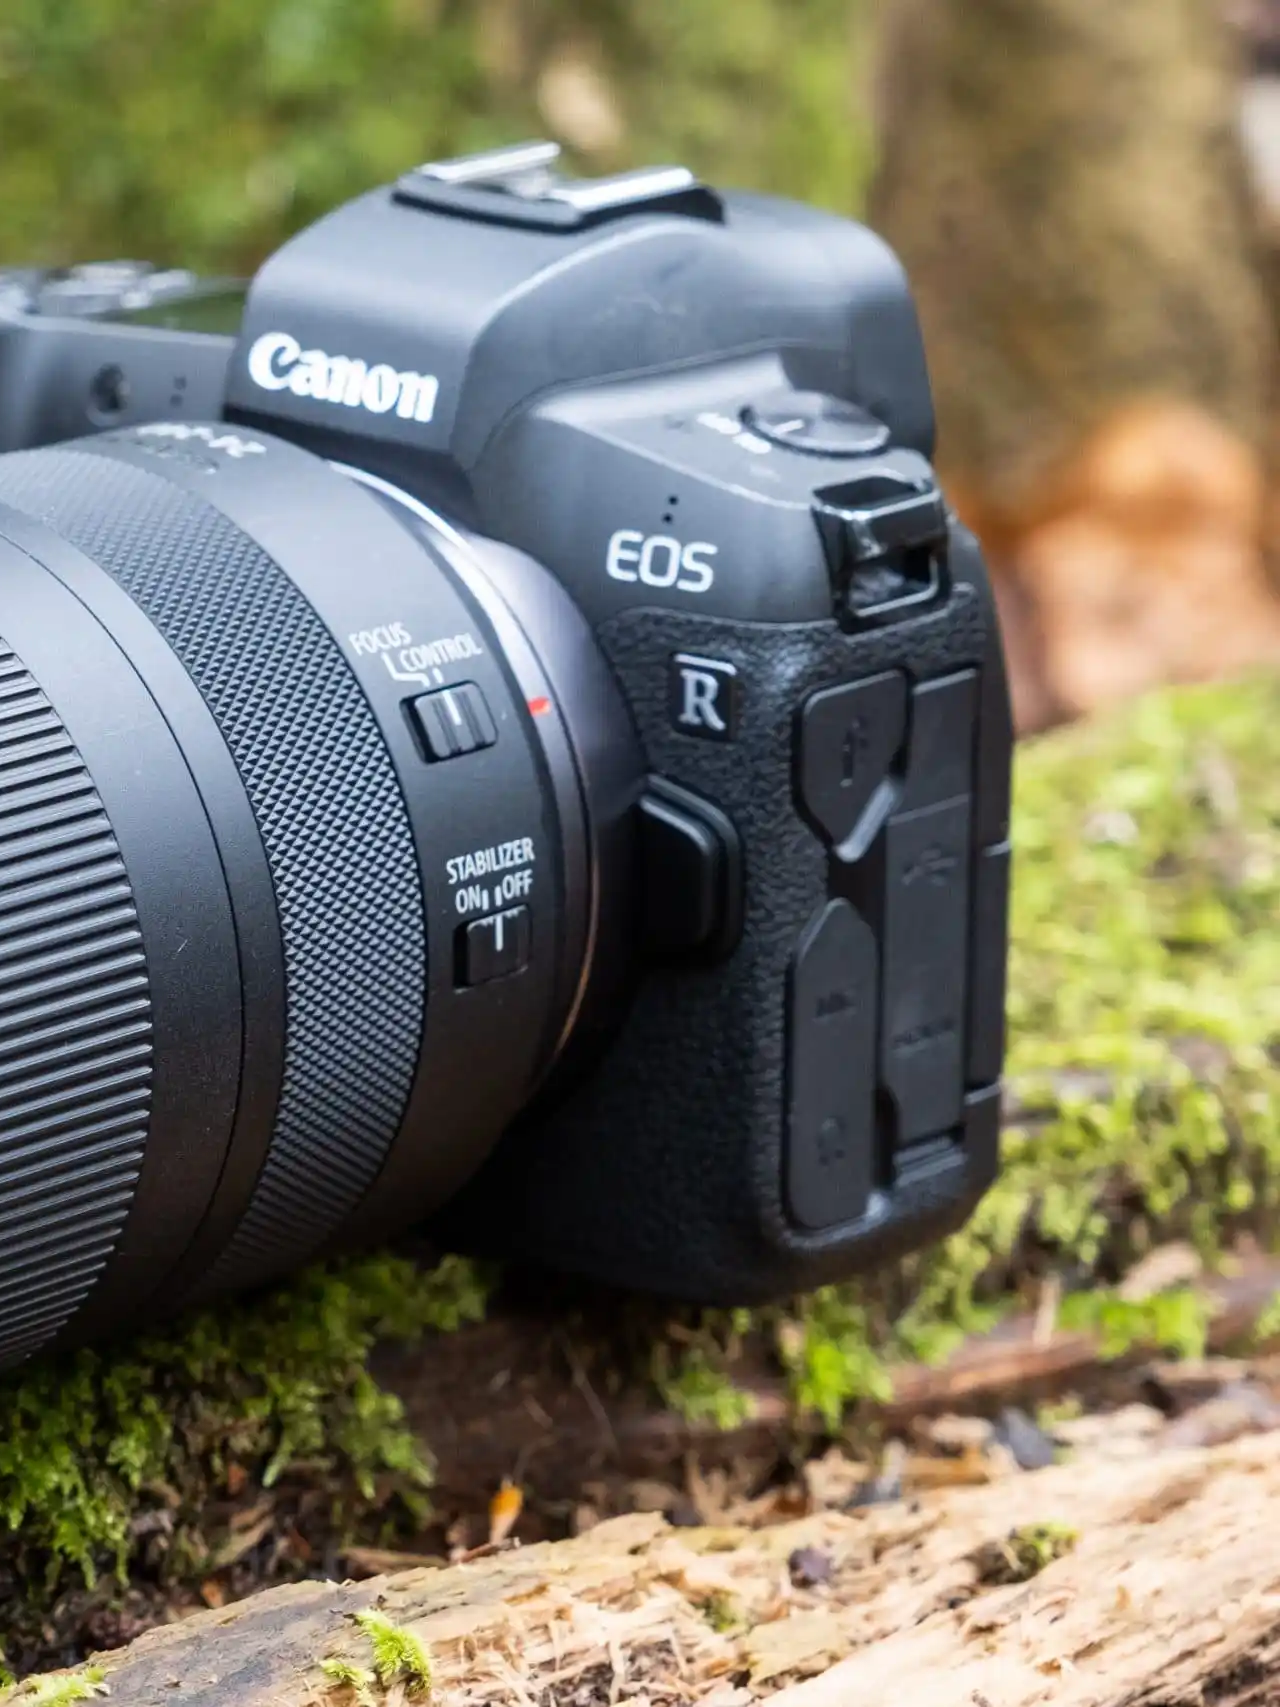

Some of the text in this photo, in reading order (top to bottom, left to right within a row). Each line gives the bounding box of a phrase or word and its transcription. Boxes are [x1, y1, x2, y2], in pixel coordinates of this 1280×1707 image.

[248, 332, 439, 423] Canon
[606, 530, 717, 592] EOS
[349, 622, 412, 656] FOCUS
[399, 633, 483, 673] CONTROL
[675, 652, 736, 731] R
[446, 837, 536, 885] STABILIZER
[455, 870, 533, 914] ON OFF
